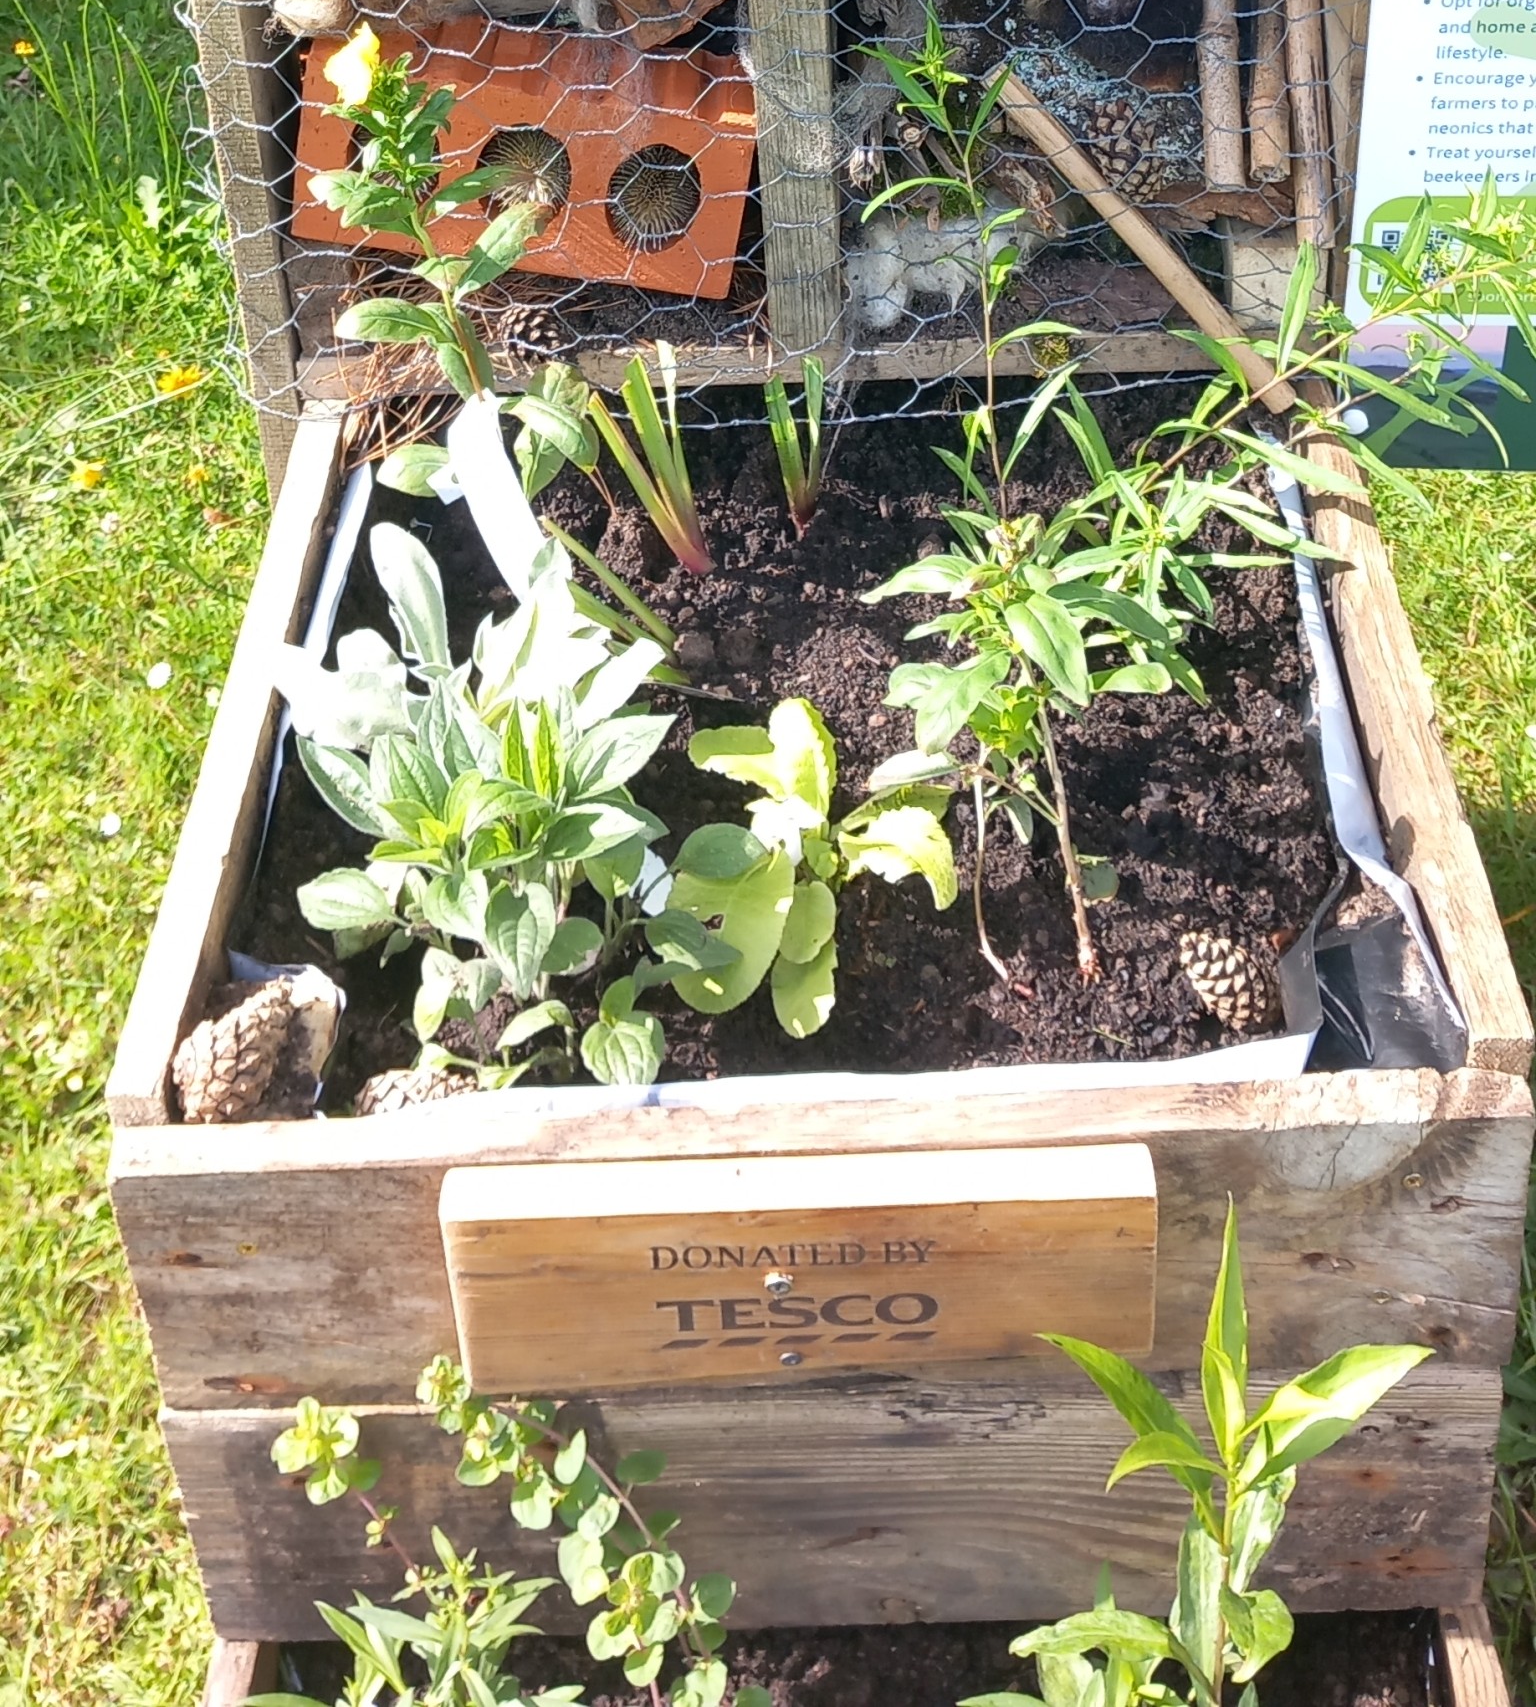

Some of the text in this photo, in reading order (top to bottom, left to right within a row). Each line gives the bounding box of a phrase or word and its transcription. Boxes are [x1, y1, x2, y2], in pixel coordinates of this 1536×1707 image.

[1438, 20, 1472, 34] and
[1476, 20, 1526, 34] home
[1436, 45, 1508, 62] lifestyle.
[1433, 72, 1525, 88] Encourage
[1430, 96, 1497, 110] farmers
[1501, 98, 1519, 110] to
[1428, 121, 1534, 135] neonics that
[1426, 146, 1470, 159] Treat
[1423, 169, 1520, 183] beekeeers
[649, 1239, 937, 1271] DONATED BY
[656, 1292, 939, 1332] TESCO
